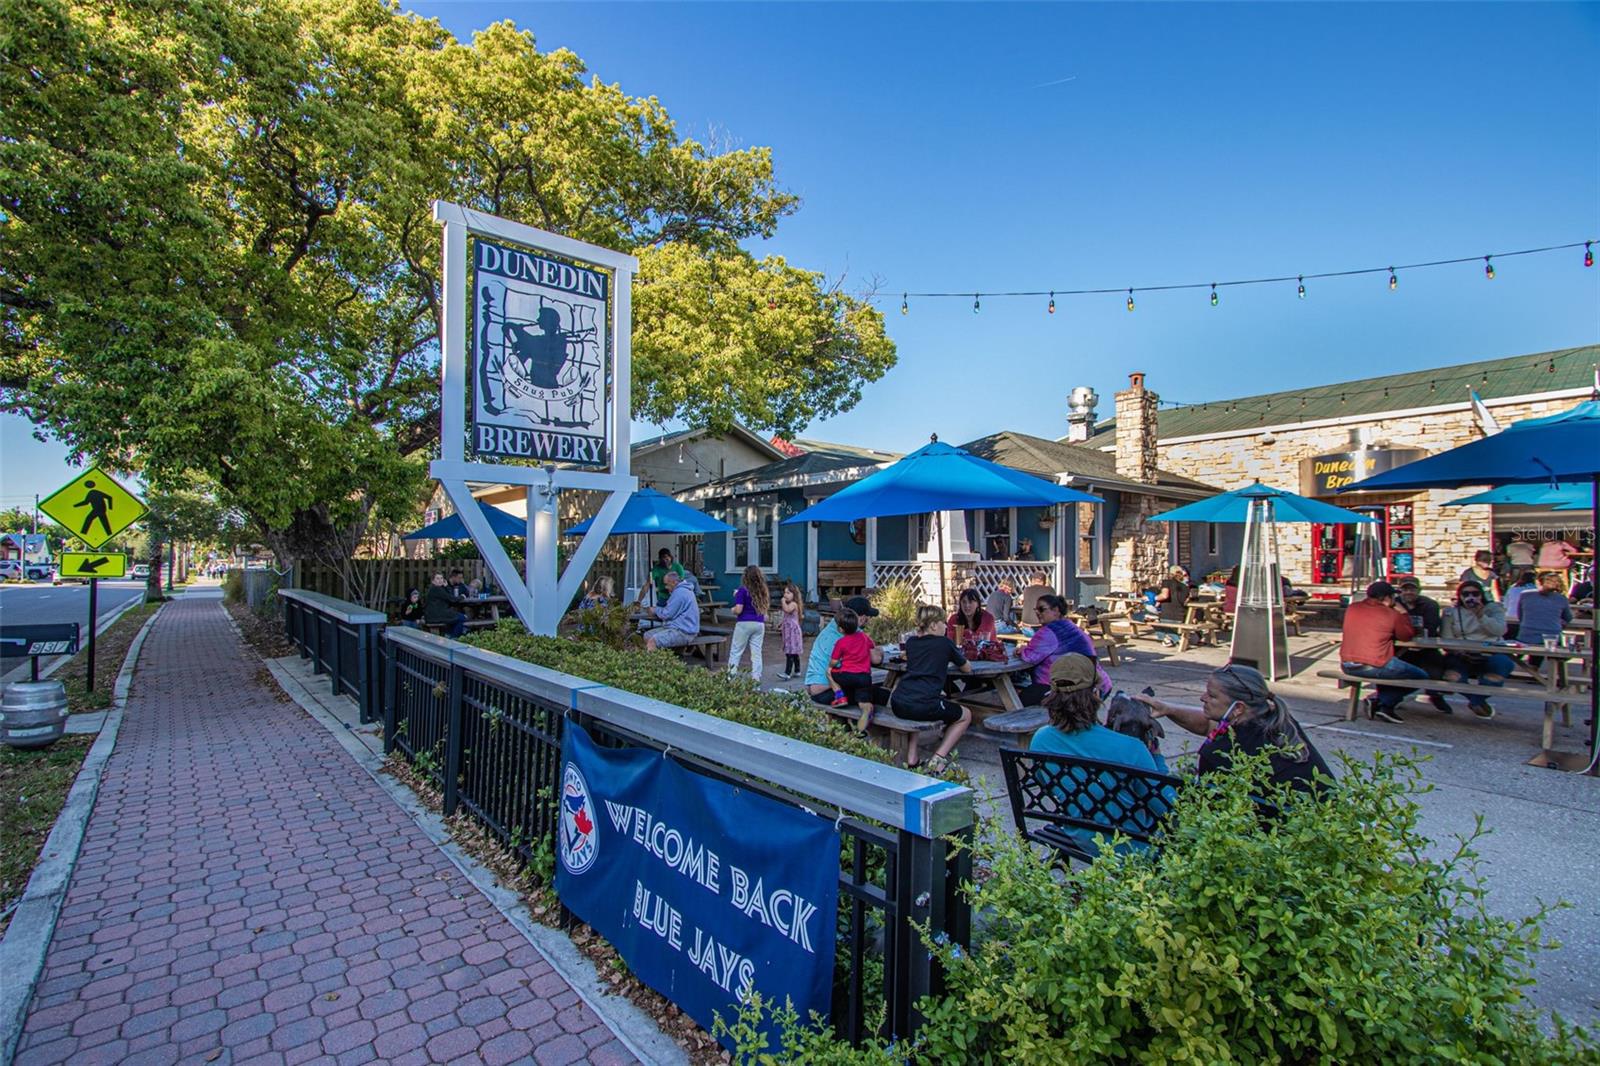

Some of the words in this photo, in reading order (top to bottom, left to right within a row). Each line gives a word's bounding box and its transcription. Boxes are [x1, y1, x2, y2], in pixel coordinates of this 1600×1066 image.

[479, 242, 605, 299] DUNEDIN
[514, 378, 545, 399] Snug
[551, 387, 574, 398] Pub
[477, 425, 604, 462] BREWERY
[1315, 458, 1376, 475] Dunen
[31, 641, 68, 653] 937
[570, 839, 593, 867] JAYS
[605, 799, 720, 894] WELCOME
[730, 865, 818, 953] BACK
[633, 879, 683, 952] BLUE
[688, 926, 756, 1004] JAYS
